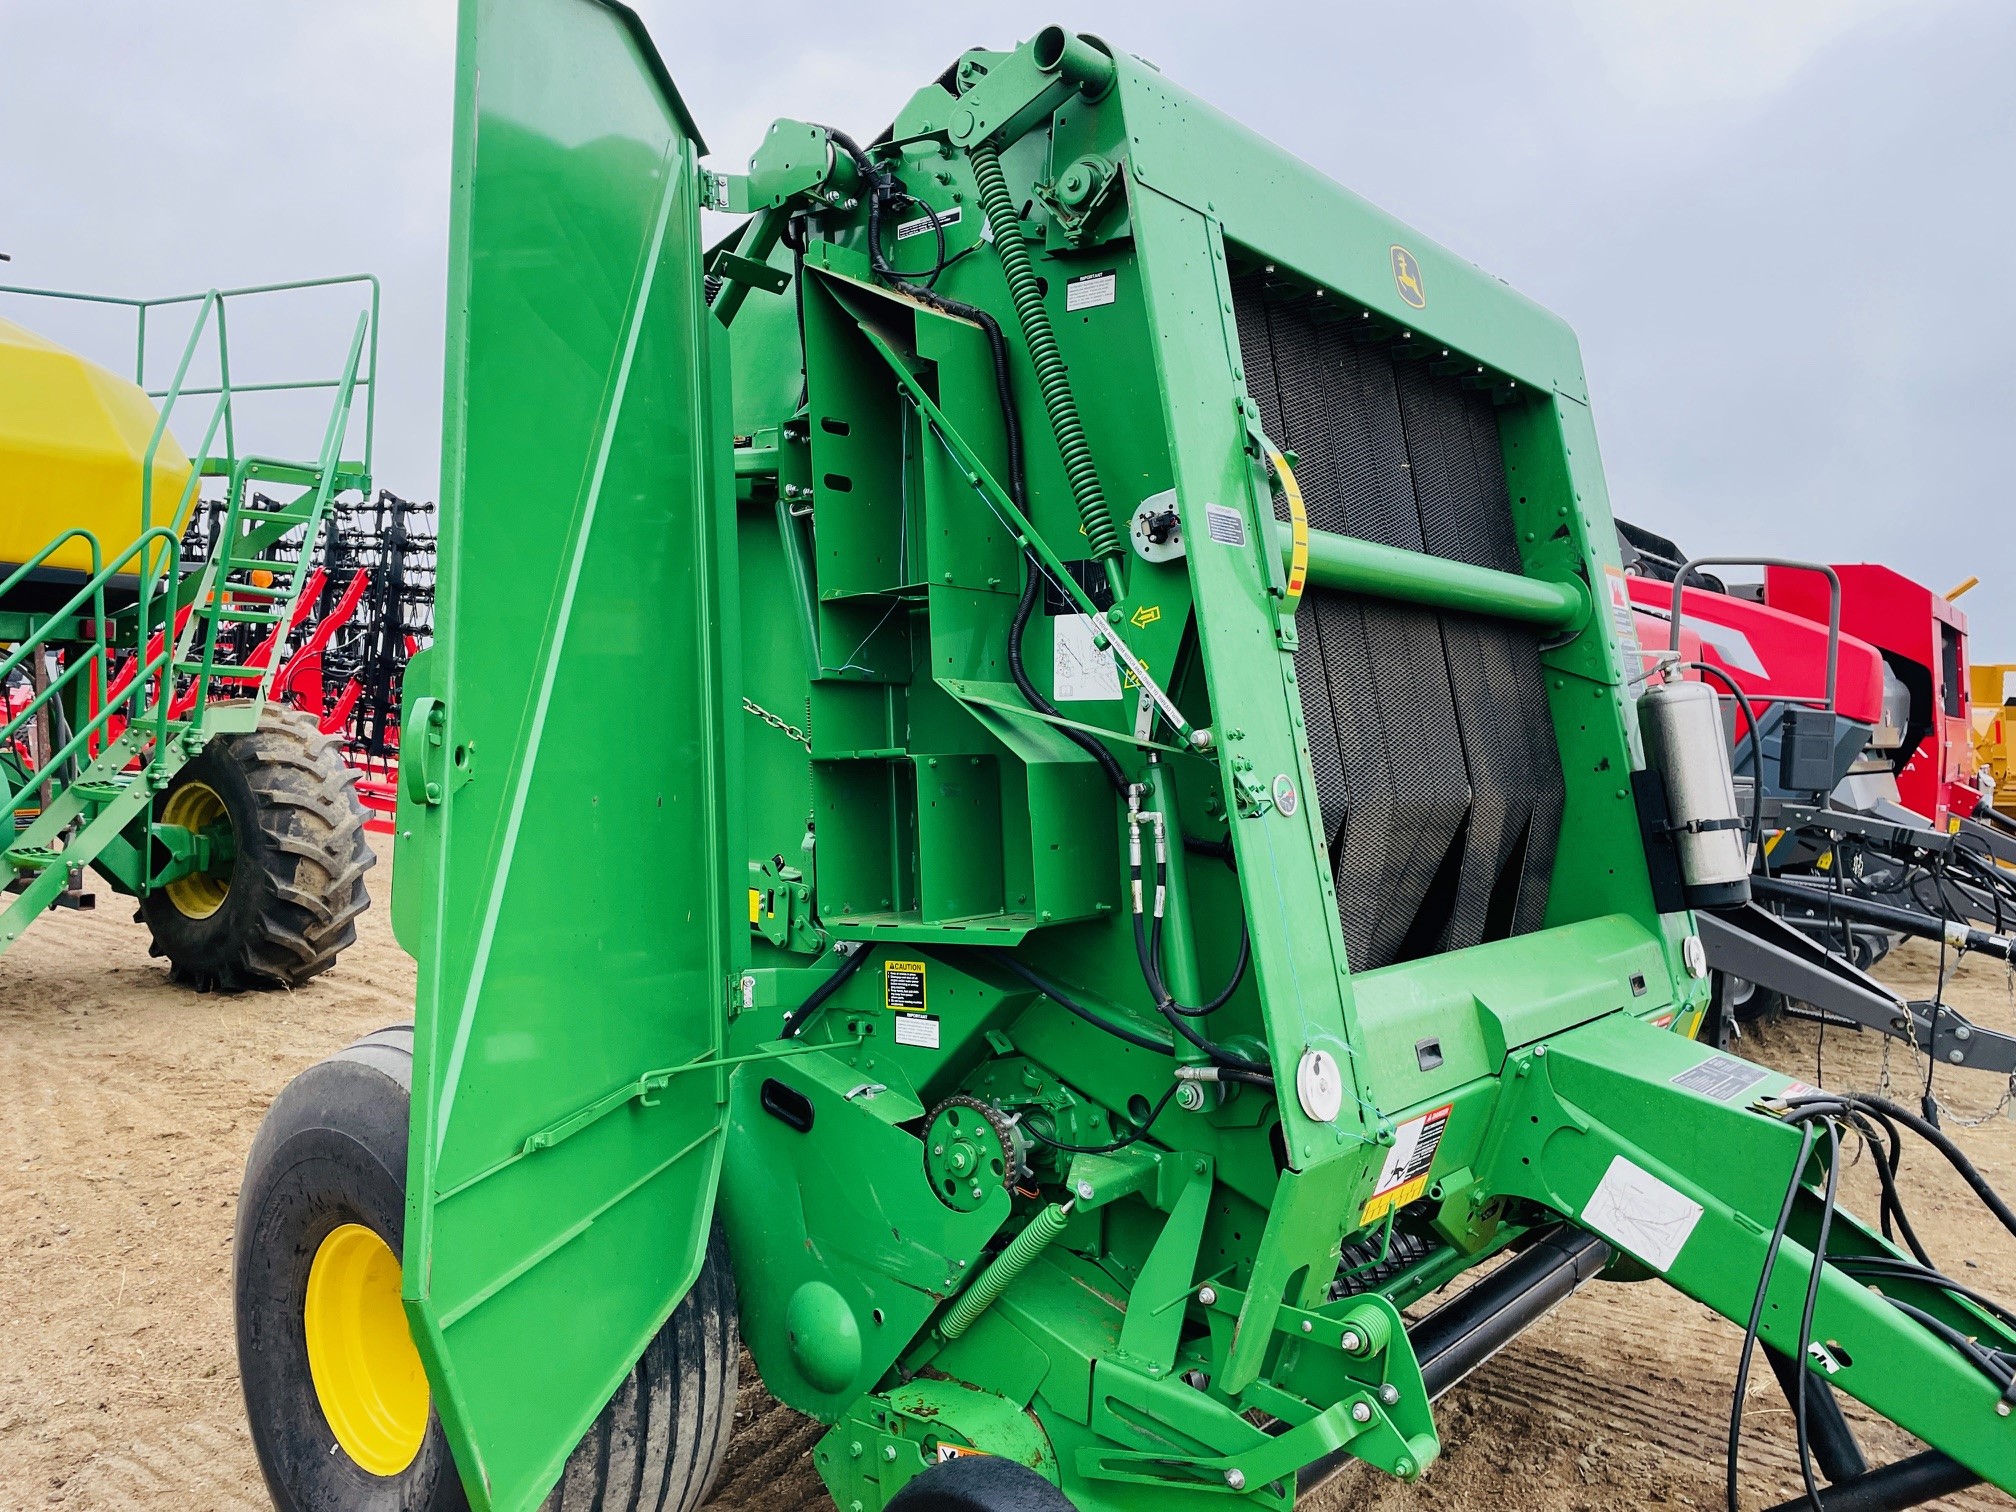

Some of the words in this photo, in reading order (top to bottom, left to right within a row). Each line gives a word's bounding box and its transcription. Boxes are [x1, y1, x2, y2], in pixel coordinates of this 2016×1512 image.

[1107, 630, 1117, 642] ARM
[1114, 640, 1126, 654] FROM
[1123, 652, 1137, 667] NOTCH
[1133, 665, 1143, 676] AND
[1140, 674, 1155, 690] LOWER
[1153, 688, 1160, 697] TO
[1157, 695, 1172, 712] THREAD
[895, 963, 921, 971] CAUTION
